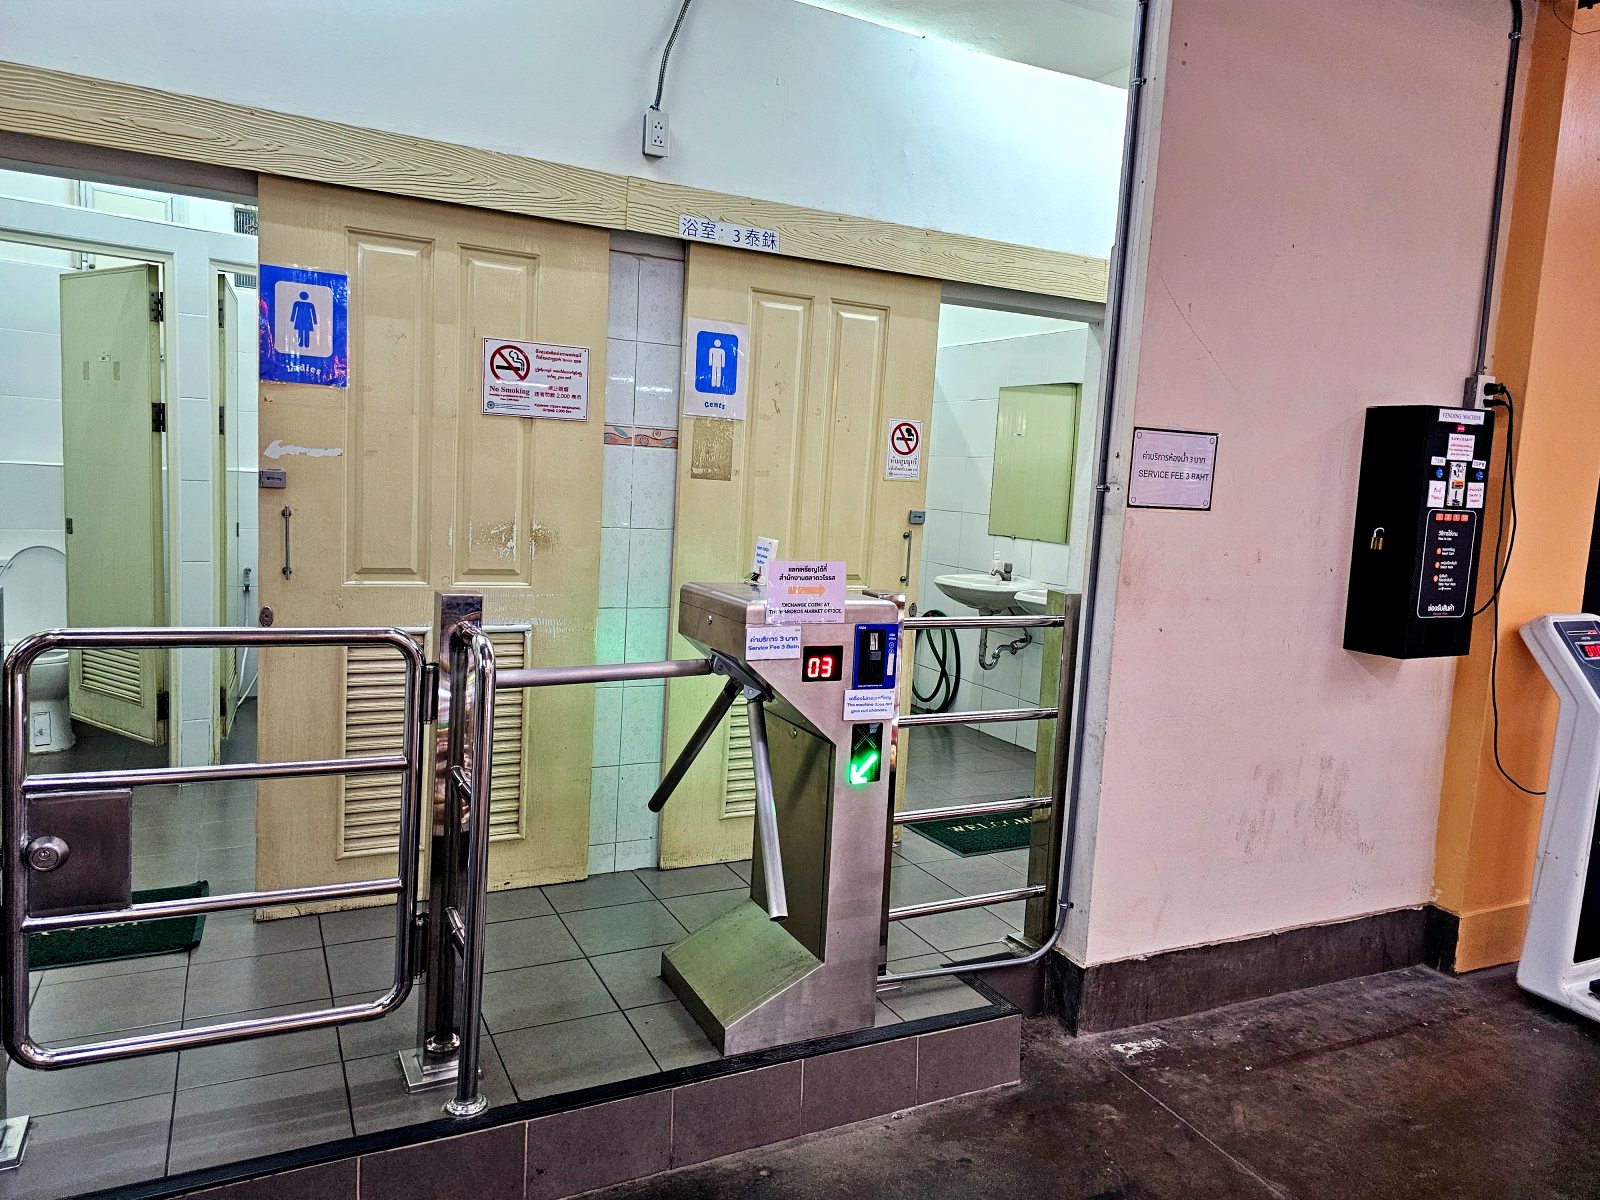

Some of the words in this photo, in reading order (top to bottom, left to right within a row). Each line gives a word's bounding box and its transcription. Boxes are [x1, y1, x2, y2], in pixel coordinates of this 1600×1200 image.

[489, 385, 499, 393] No
[501, 386, 530, 396] Smoking
[704, 401, 726, 410] Gents
[1442, 412, 1462, 420] VENDING
[1138, 469, 1170, 479] SERVICE
[1170, 471, 1184, 480] FEE
[1185, 472, 1190, 480] 3
[1191, 473, 1210, 481] BAHT
[788, 563, 828, 573] แลกเหรียญได้ที่
[779, 573, 836, 581] สำนักงานตลาดวโรรส
[807, 657, 833, 678] 03
[948, 816, 1033, 832] WELCOM
